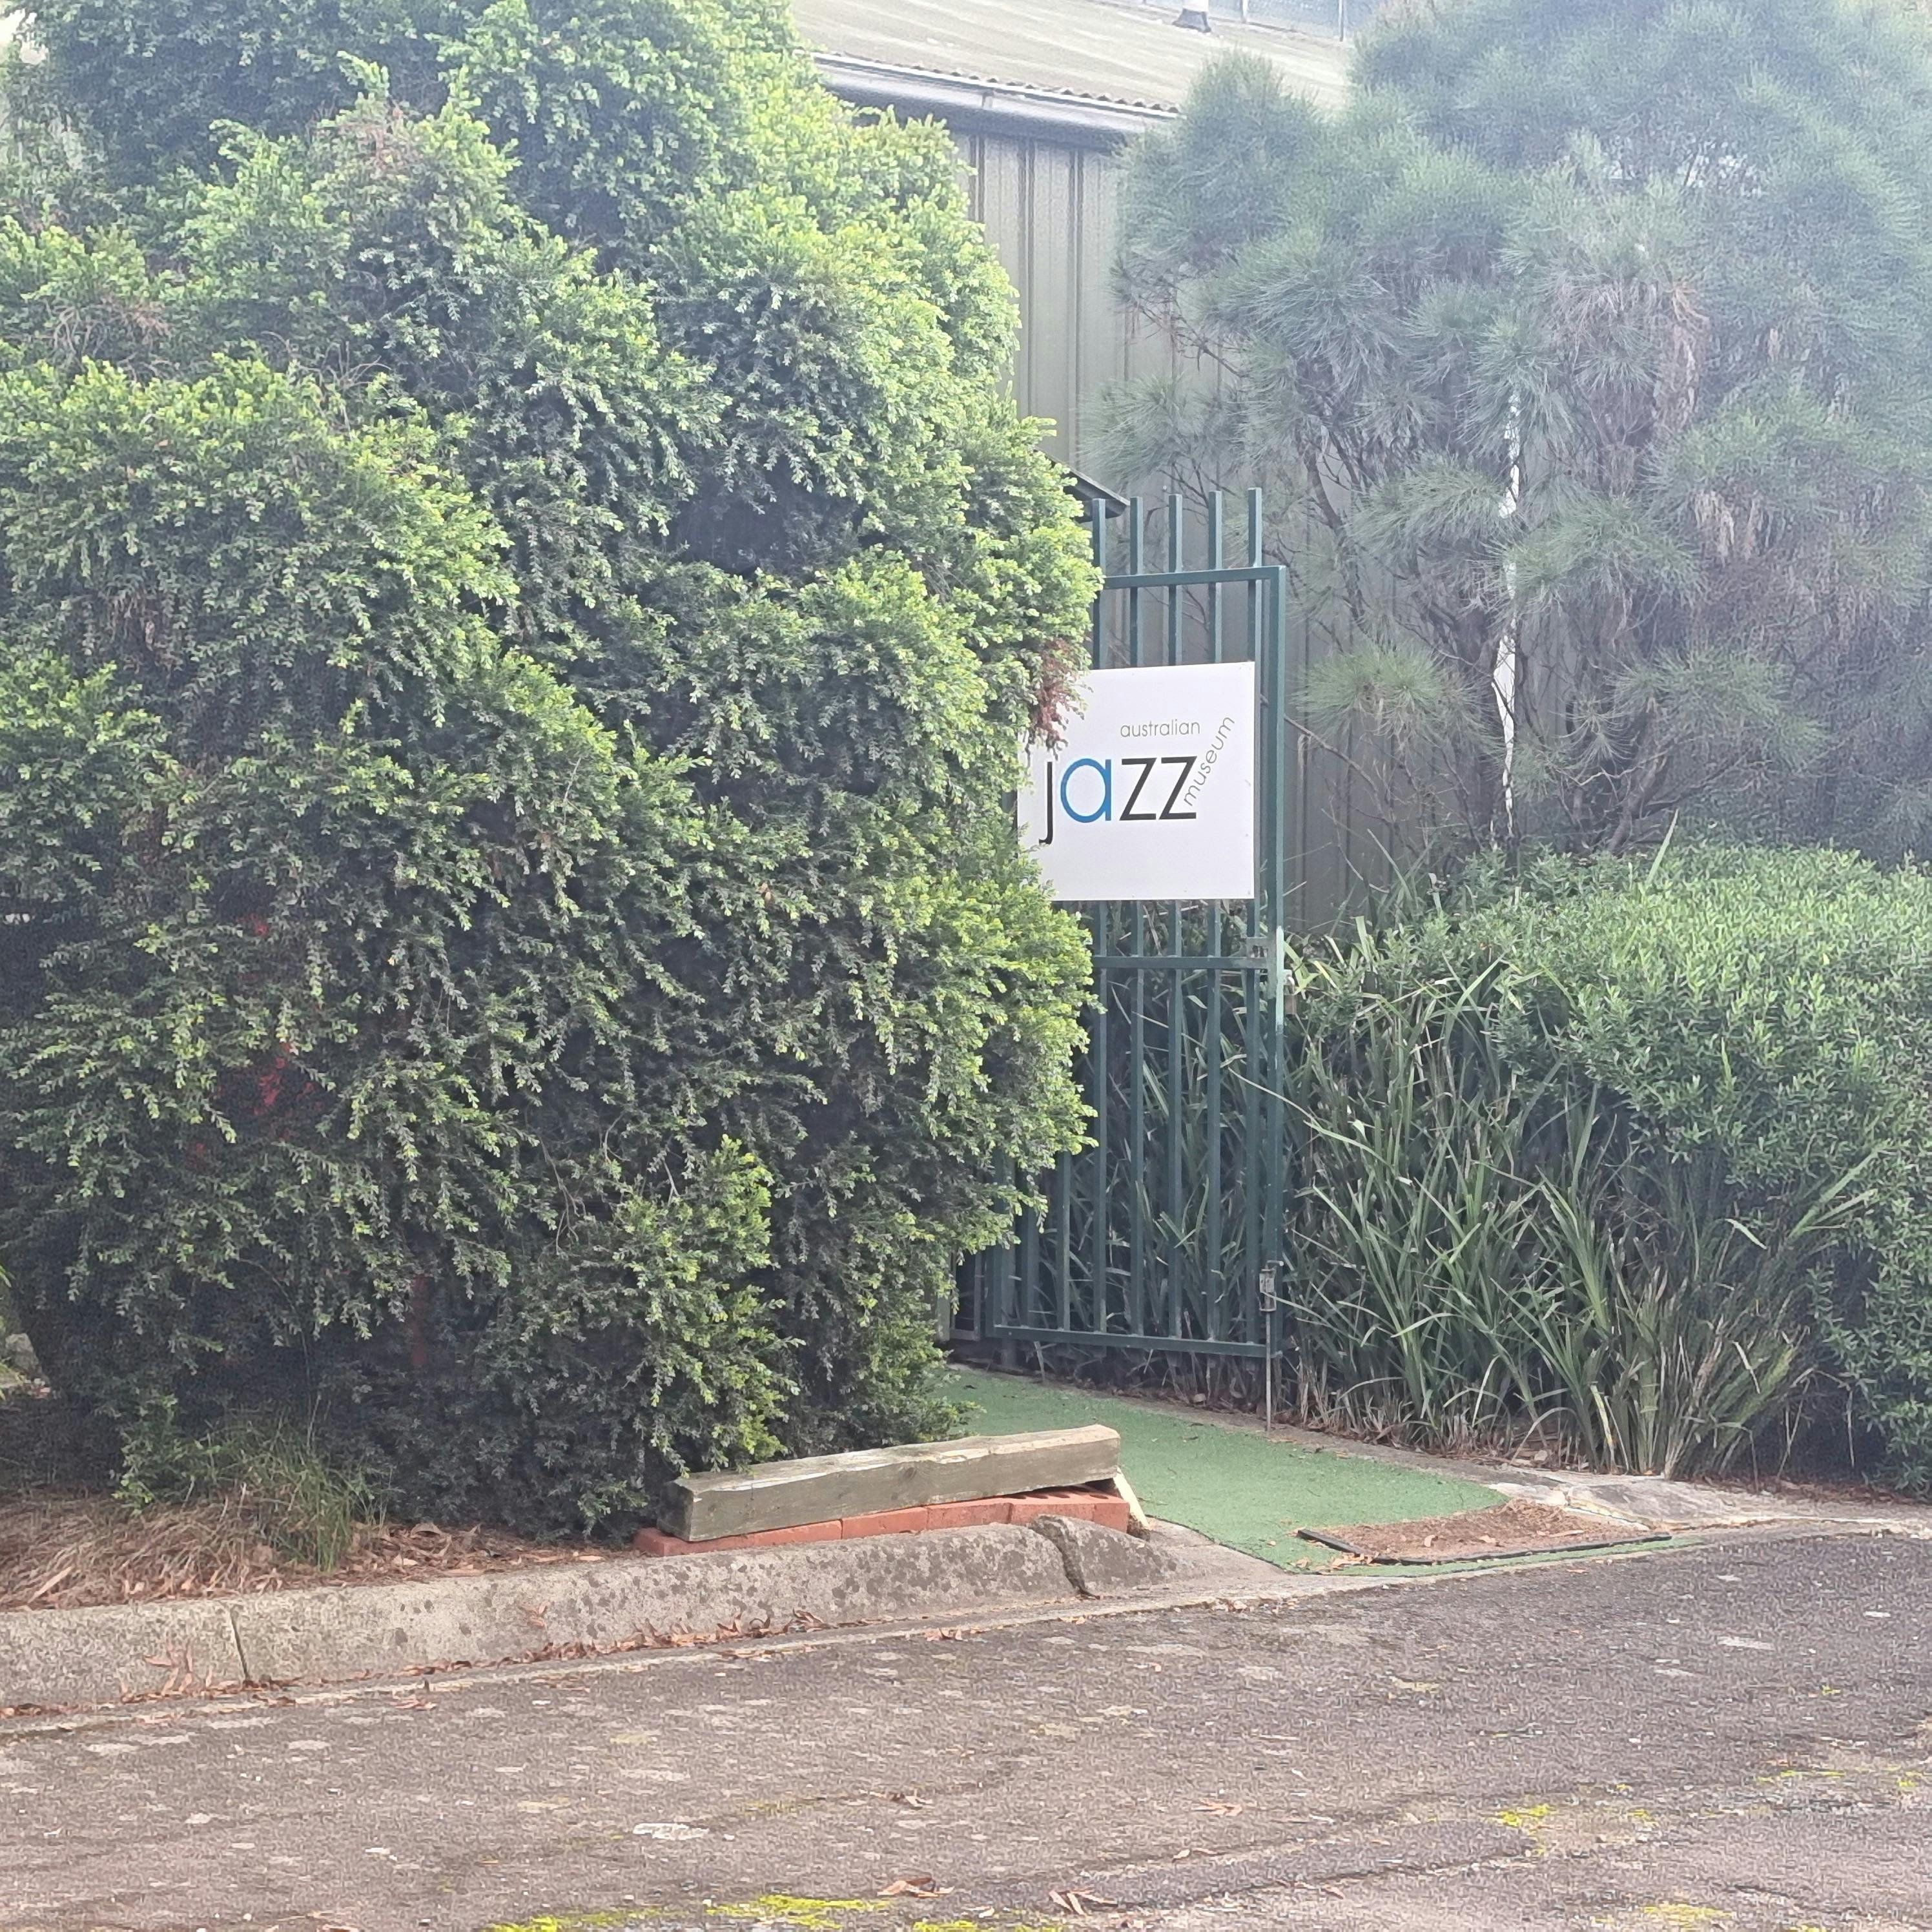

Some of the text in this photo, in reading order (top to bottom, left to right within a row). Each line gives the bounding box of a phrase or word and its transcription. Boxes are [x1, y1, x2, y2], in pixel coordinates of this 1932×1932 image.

[1120, 719, 1200, 737] australian
[1183, 716, 1235, 807] museum
[1038, 755, 1198, 845] jazz
